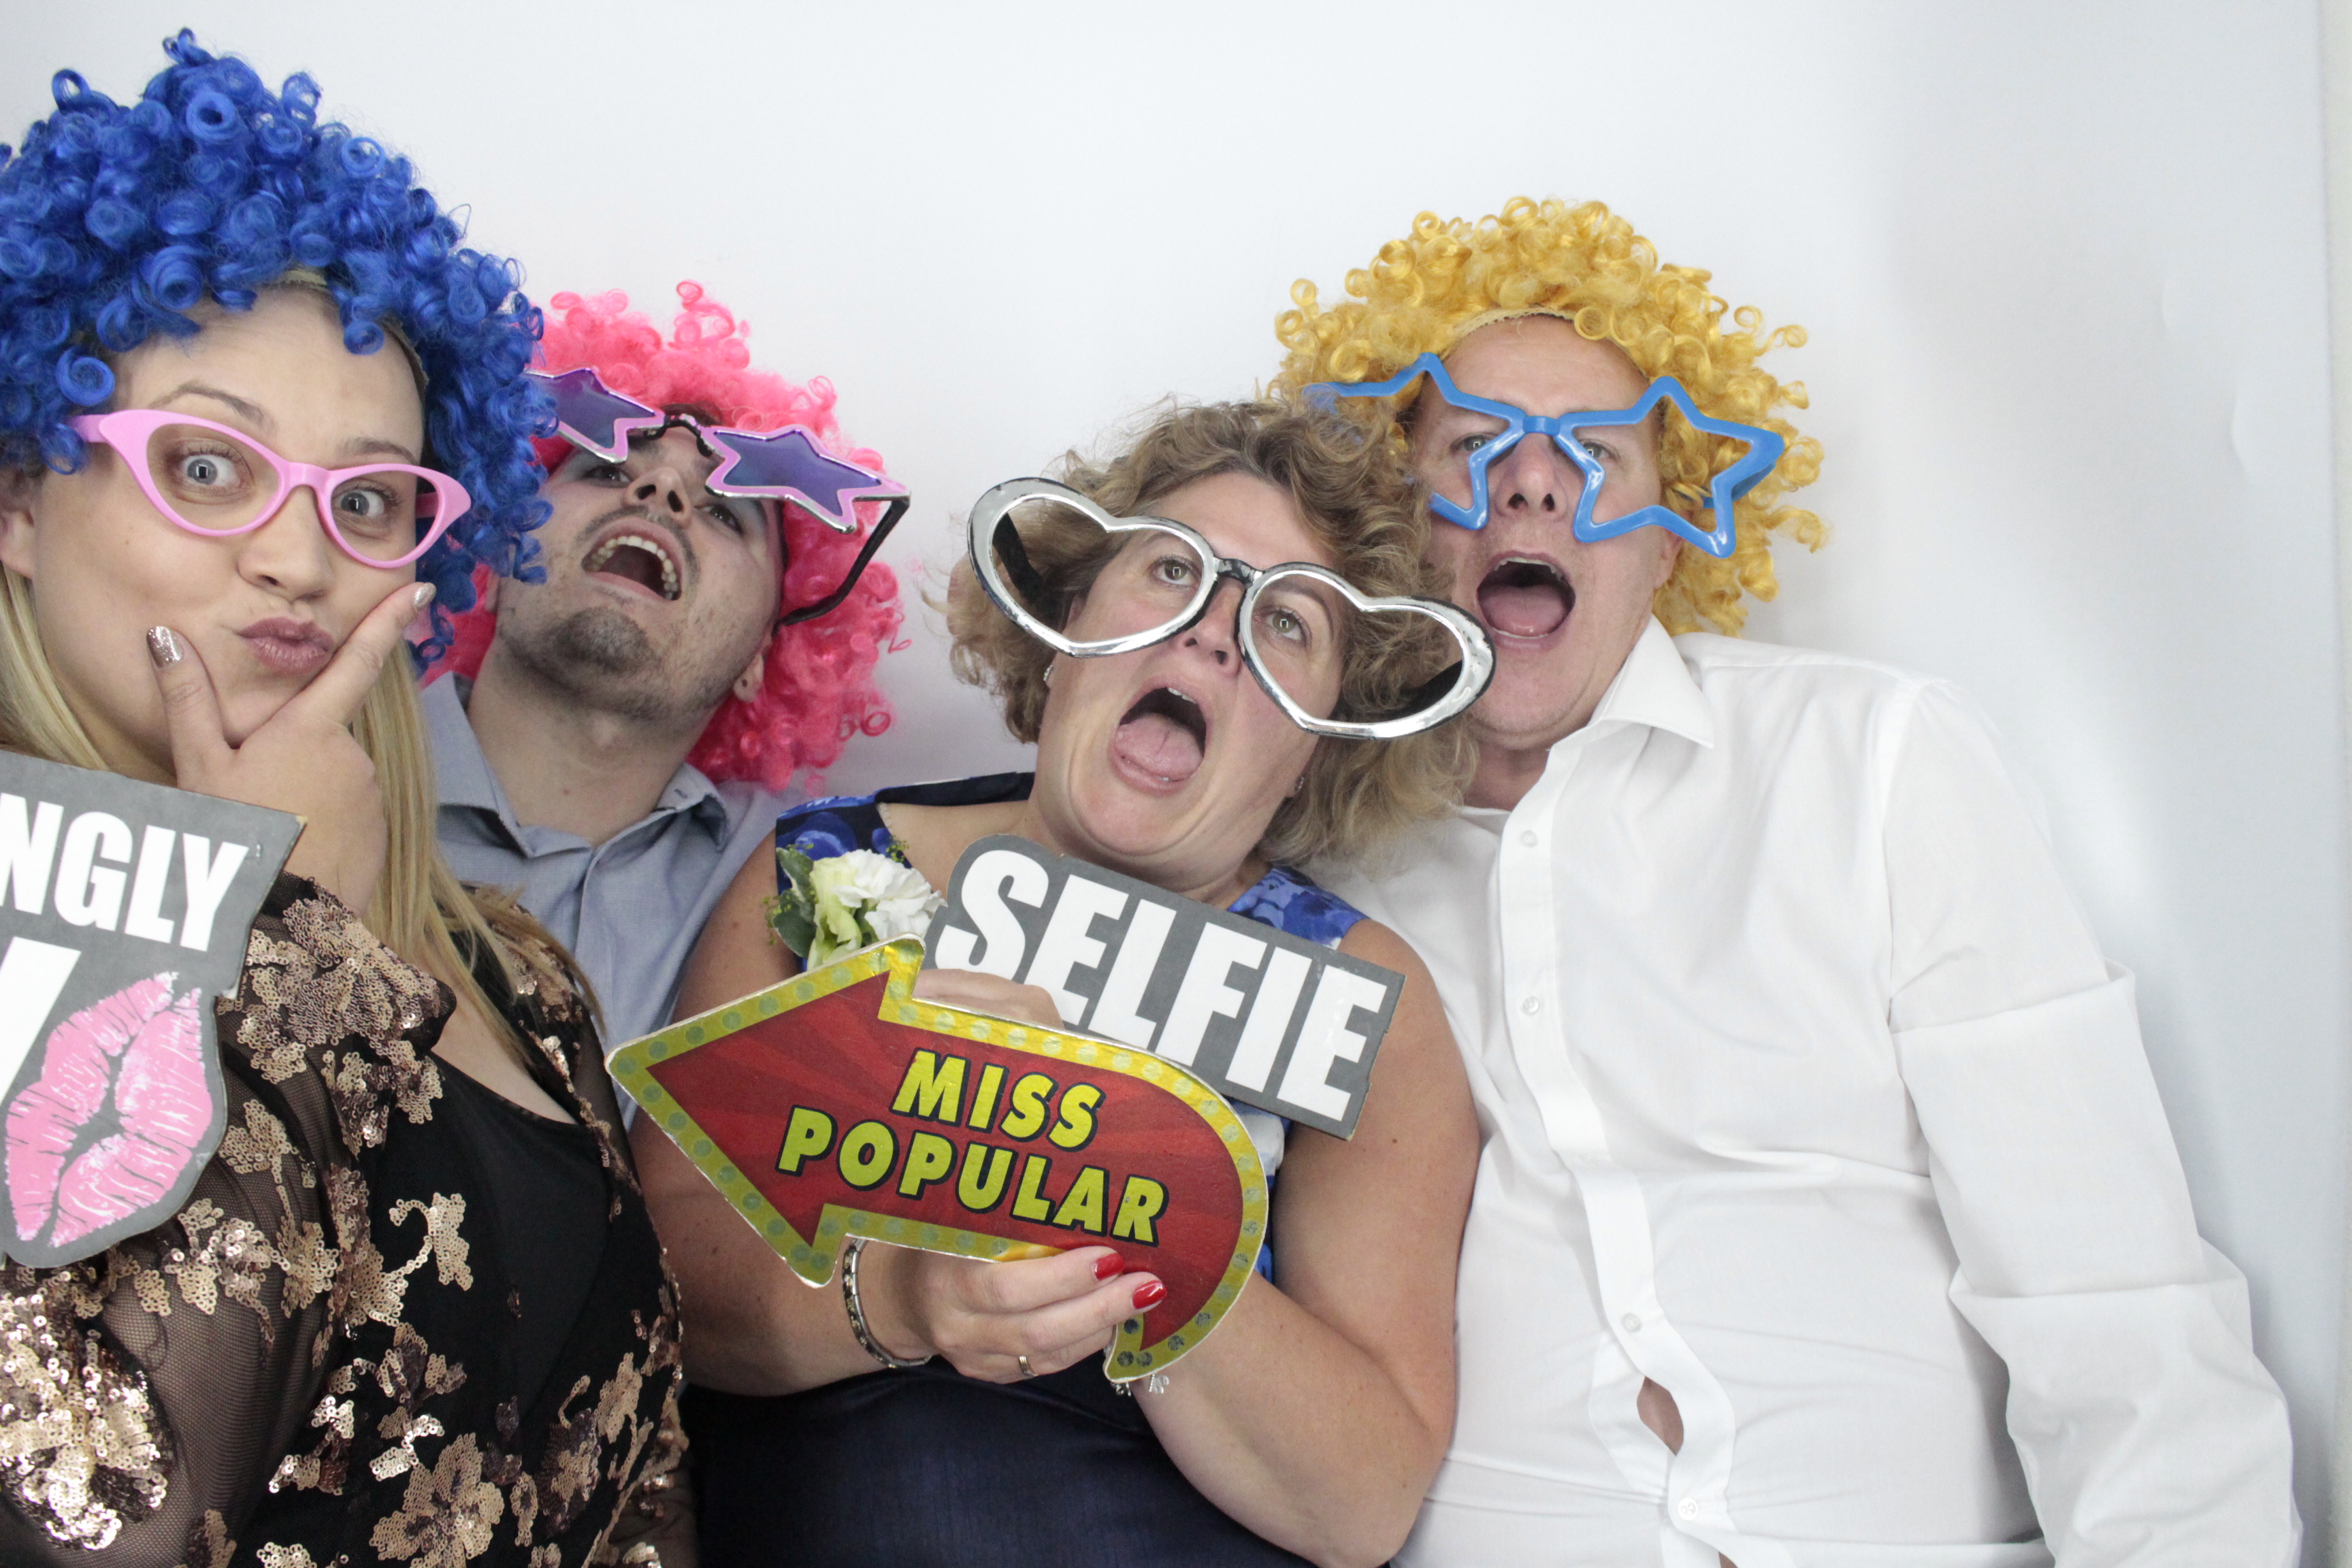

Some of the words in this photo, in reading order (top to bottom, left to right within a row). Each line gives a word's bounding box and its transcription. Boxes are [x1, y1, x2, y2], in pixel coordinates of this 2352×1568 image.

[934, 849, 1388, 1122] SELFIE
[889, 1047, 1107, 1152] MISS
[775, 1105, 1169, 1247] POPULAR
